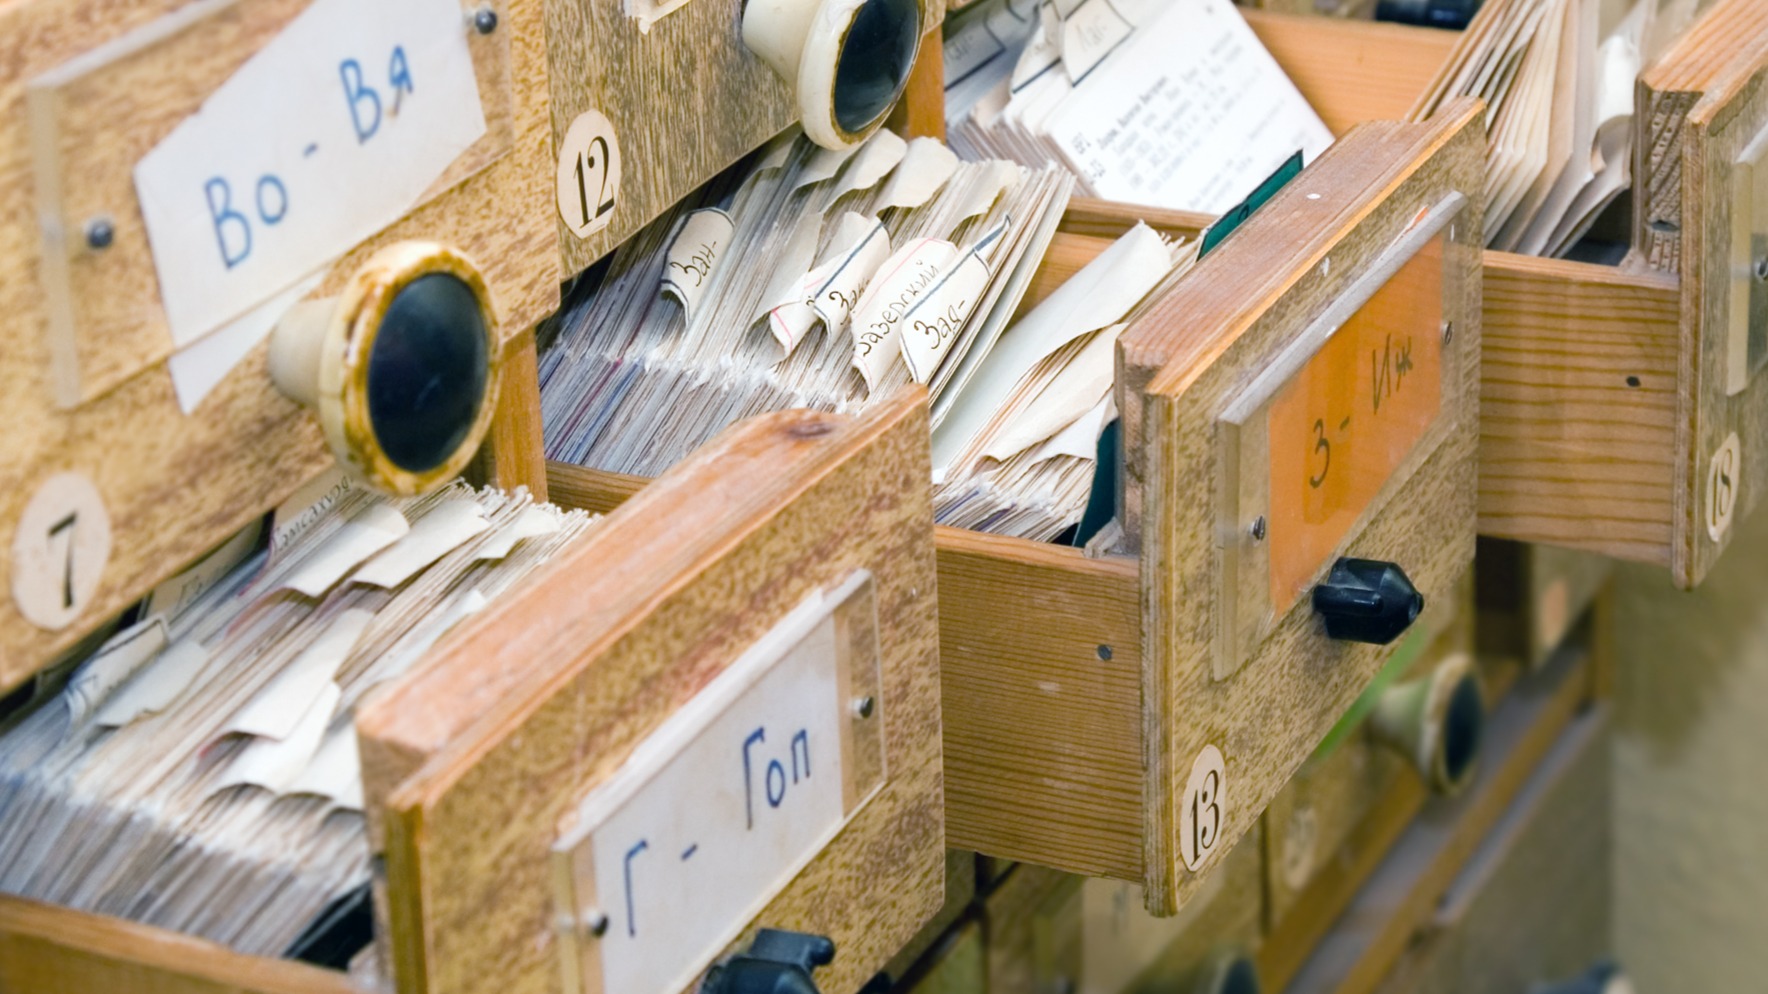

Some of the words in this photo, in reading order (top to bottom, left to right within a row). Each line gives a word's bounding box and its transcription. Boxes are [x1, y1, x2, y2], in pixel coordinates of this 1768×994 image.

[205, 175, 288, 269] Во
[339, 44, 413, 144] Вя
[573, 135, 615, 229] 12
[1711, 448, 1733, 527] 18
[48, 510, 77, 608] 7
[624, 839, 649, 938] Г
[742, 727, 811, 831] Гоп
[1189, 769, 1220, 867] 13
